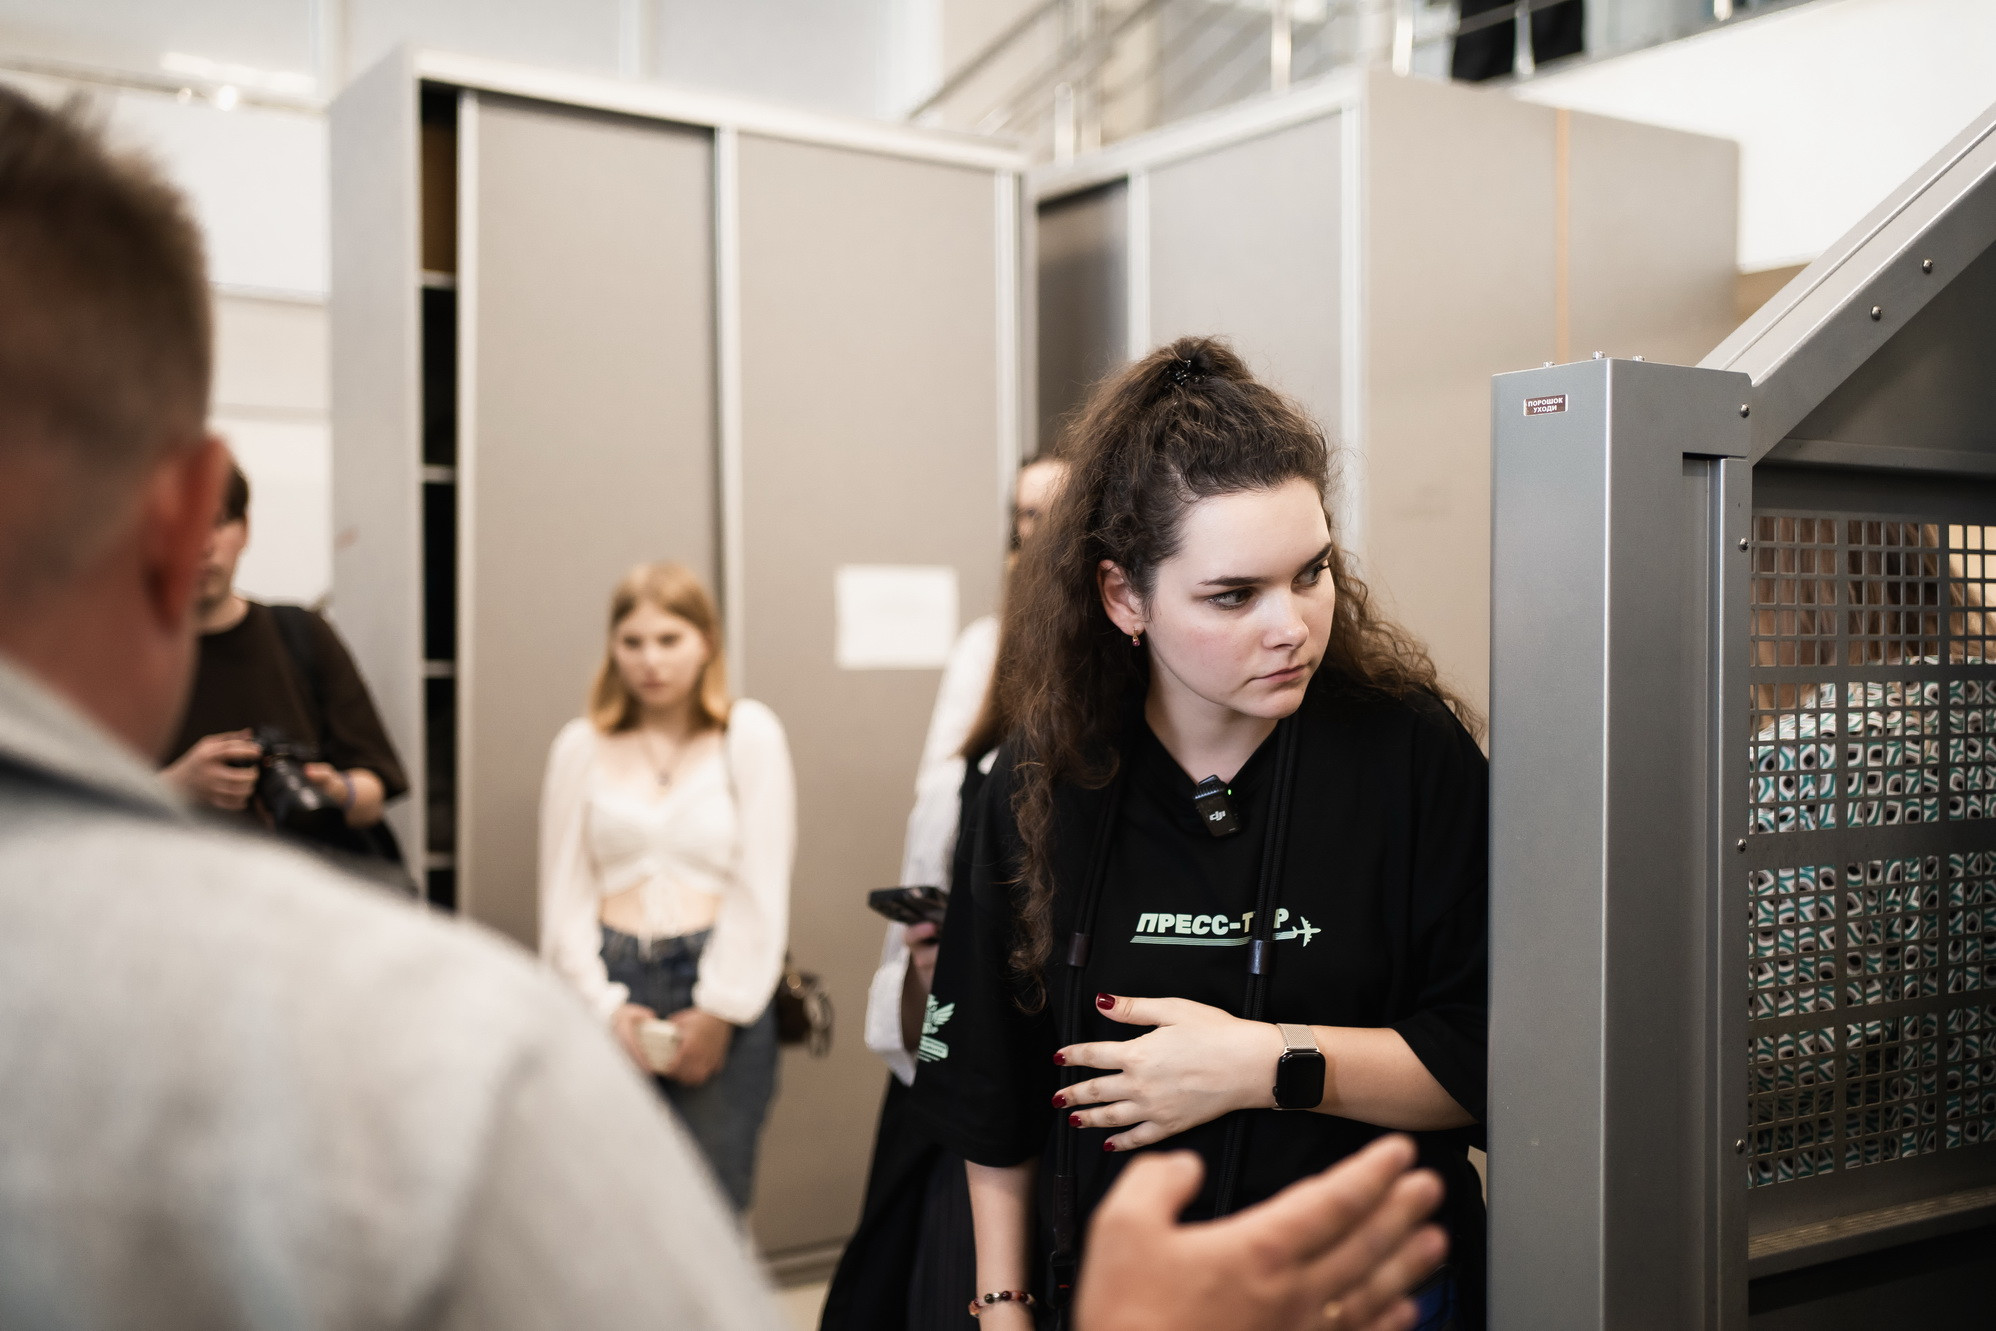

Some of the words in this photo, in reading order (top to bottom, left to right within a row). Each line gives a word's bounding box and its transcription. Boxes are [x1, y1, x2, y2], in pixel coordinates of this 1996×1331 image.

[1528, 397, 1564, 407] ПОРОШОК
[1533, 405, 1558, 413] УХОДИ
[1136, 908, 1290, 935] ПРЕСС-ТР
